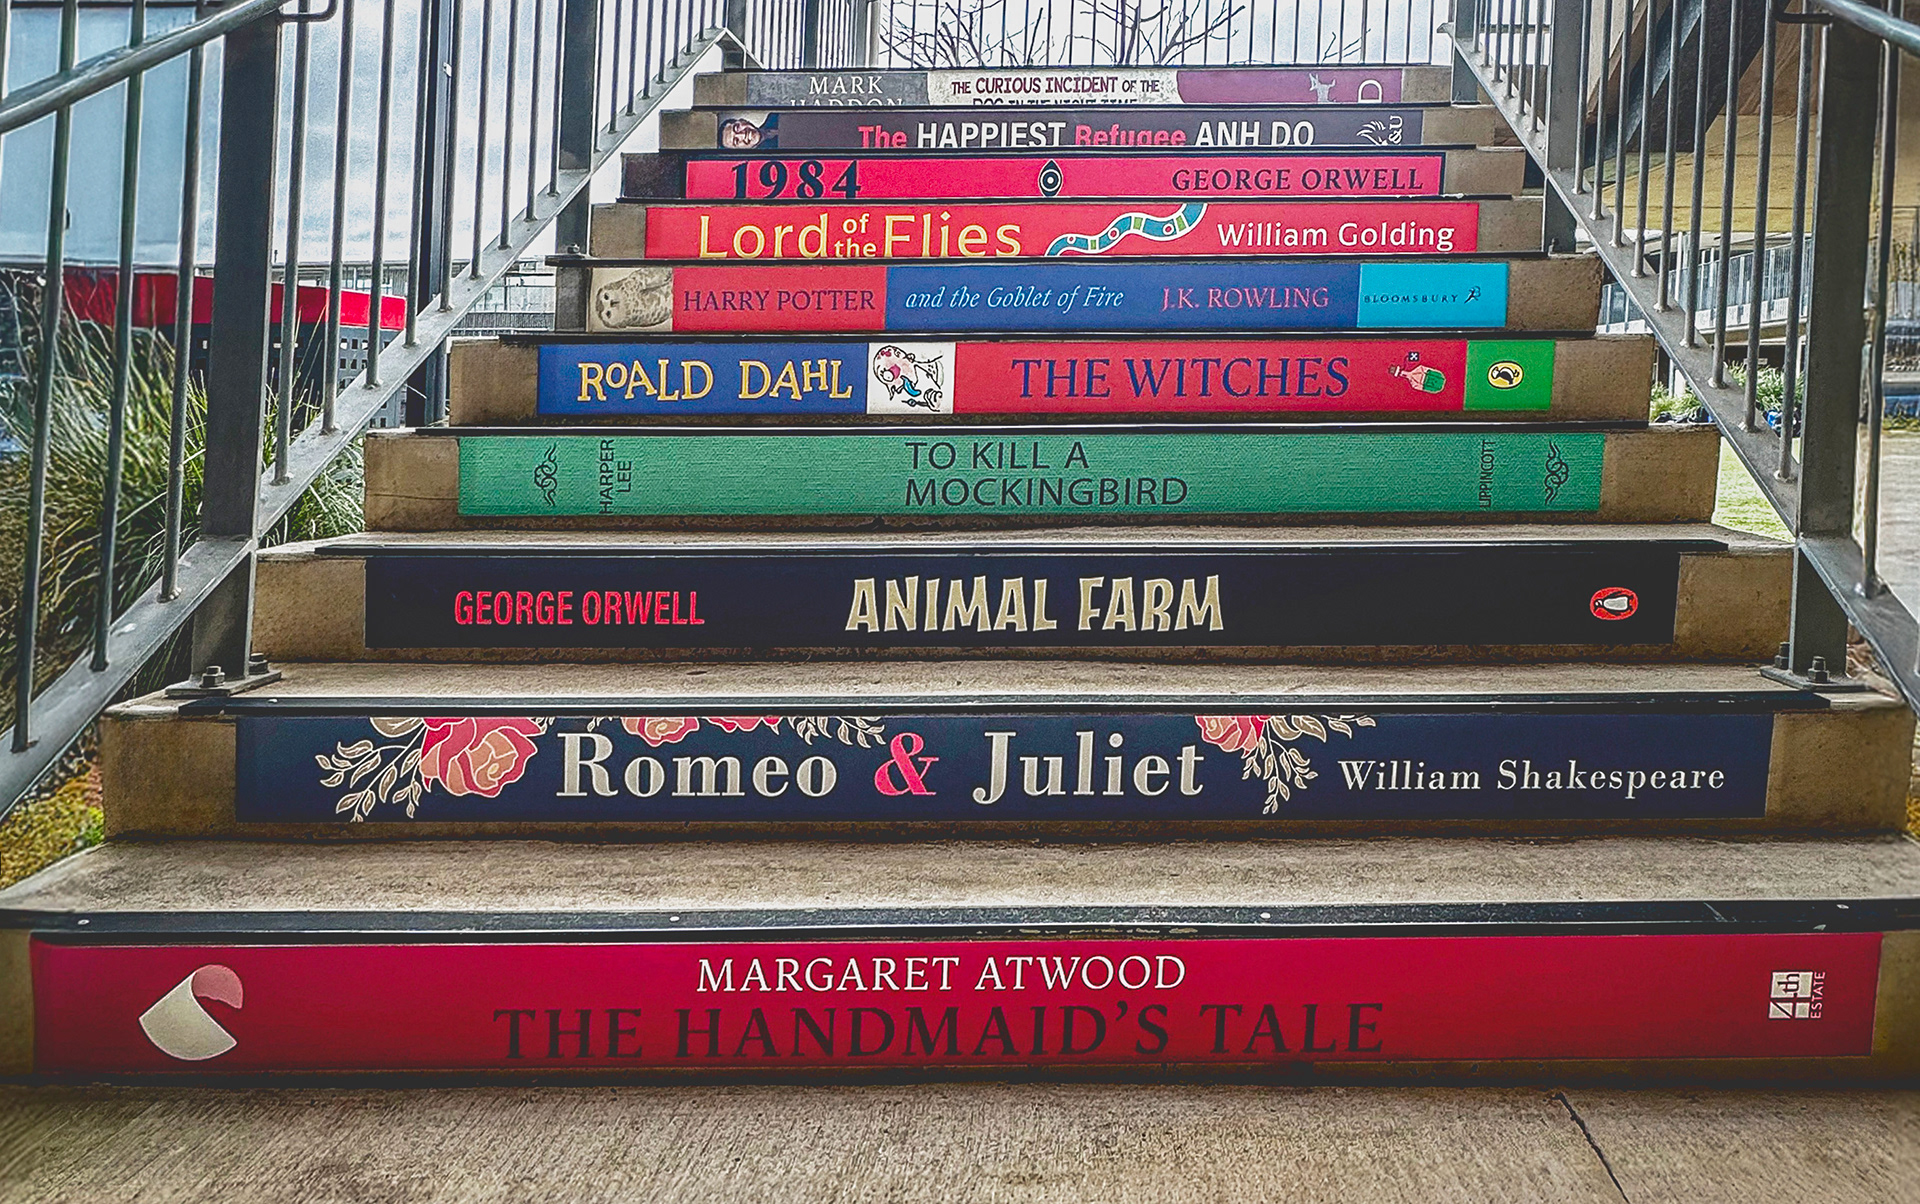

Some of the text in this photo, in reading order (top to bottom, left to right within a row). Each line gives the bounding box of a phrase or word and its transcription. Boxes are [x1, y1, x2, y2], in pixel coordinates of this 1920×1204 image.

[809, 76, 884, 95] MARK
[951, 76, 1160, 95] THE CURIOUS INCIDENT OF THE
[857, 121, 1186, 147] The HAPPIEST Refugee
[1195, 120, 1315, 146] ANH DO
[731, 160, 862, 198] 1984
[1172, 168, 1424, 191] GEORGE ORWELL
[699, 210, 1023, 258] Lord of the Flies
[1217, 222, 1455, 251] William Golding
[683, 289, 876, 312] HARRY POTTER
[905, 284, 1125, 313] and the Goblet of Fire
[1161, 287, 1330, 311] J.K. ROWLING
[1364, 293, 1459, 305] BLOOMSBURY
[576, 358, 854, 402] ROALD DAHL
[1012, 356, 1350, 398] THE WITCHES
[905, 441, 1091, 470] TO KILL A
[600, 438, 615, 515] HARPER
[616, 460, 633, 493] LEE
[1479, 440, 1496, 509] LIPPINCOTT
[905, 477, 1189, 507] MOCKINGBIRD
[454, 590, 706, 626] GEORGE ORWELL
[845, 574, 1224, 633] ANIMAL FARM
[556, 730, 1205, 805] Romeo & Juliet
[1337, 758, 1726, 800] William Shakespeare
[696, 954, 1187, 993] MARGARET ATWOOD
[1810, 971, 1826, 1019] ESTATE
[493, 1000, 1385, 1059] THE HANDMAID'S TALE
